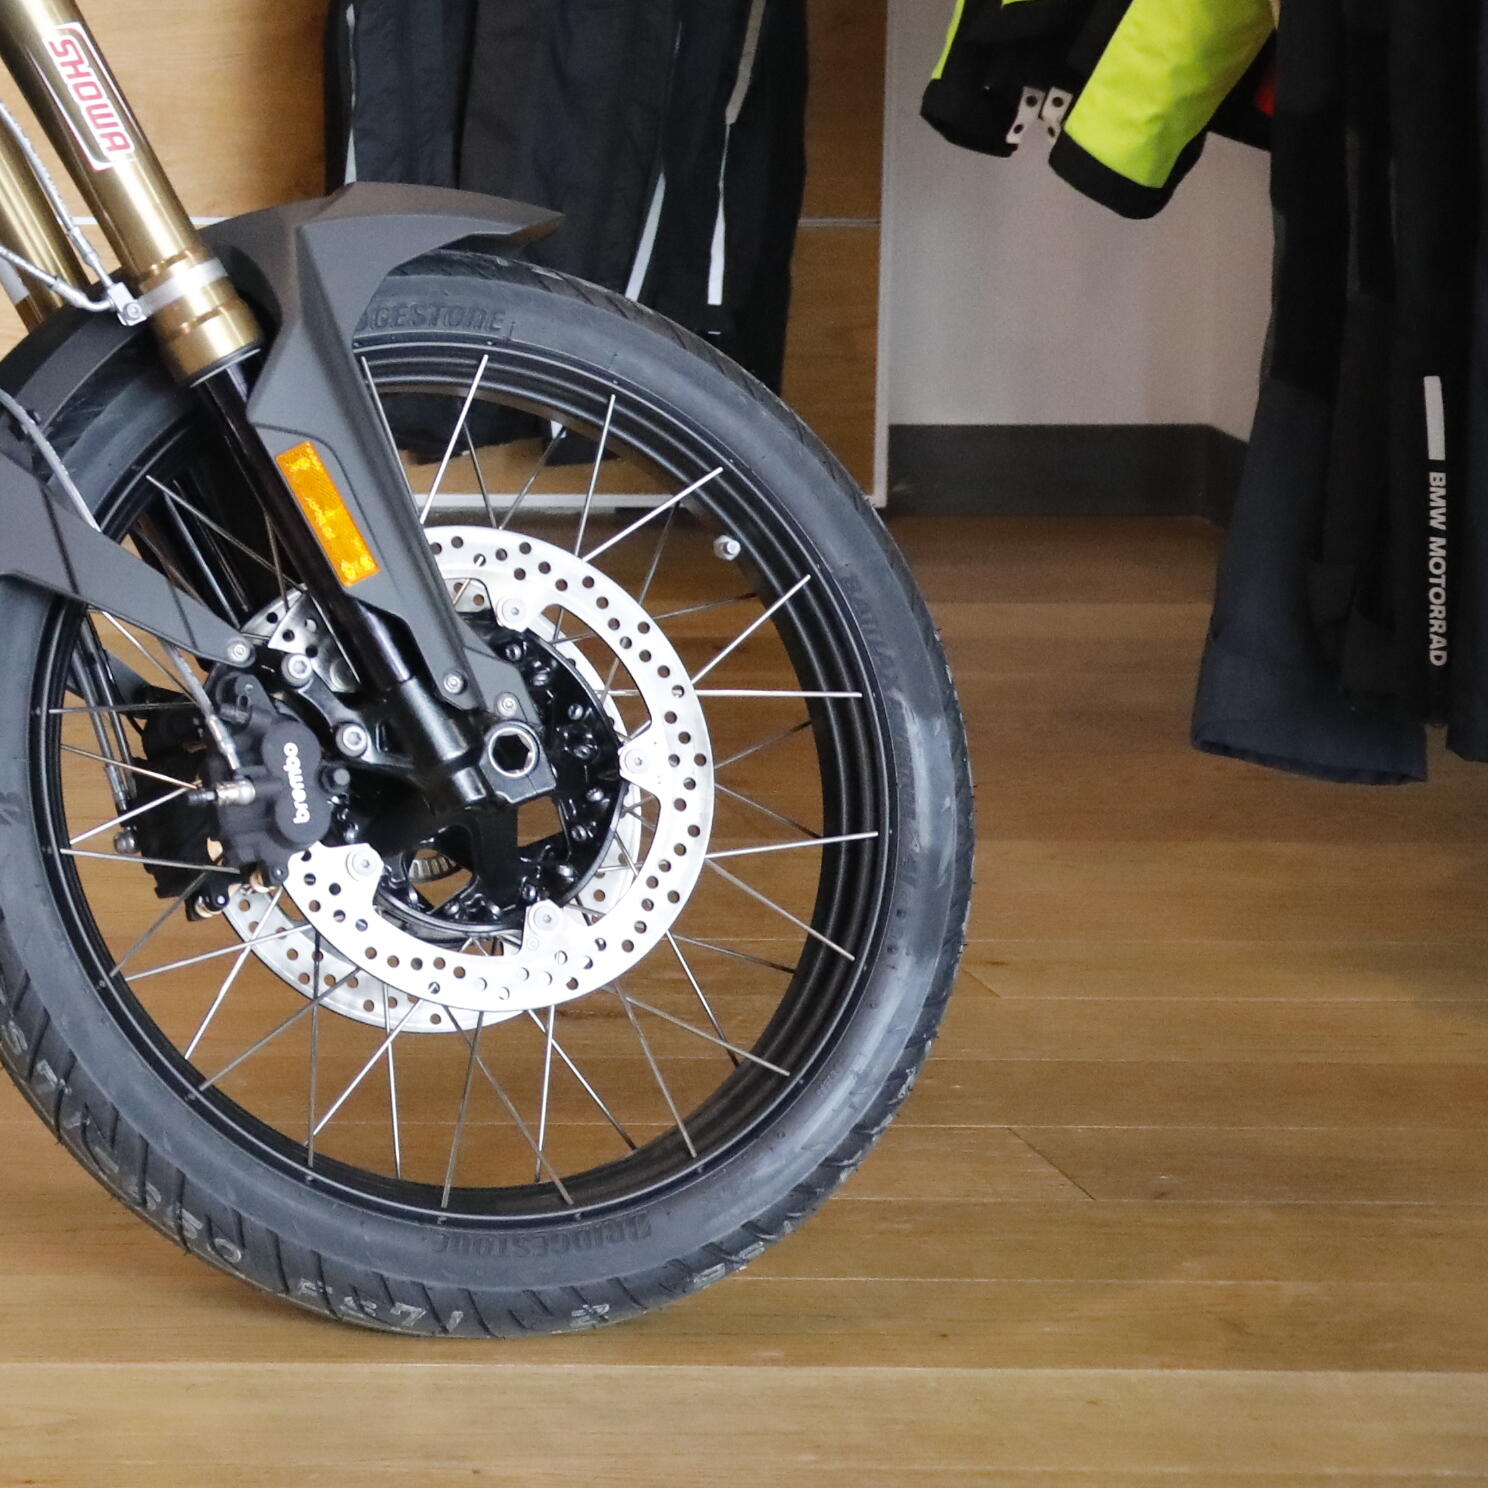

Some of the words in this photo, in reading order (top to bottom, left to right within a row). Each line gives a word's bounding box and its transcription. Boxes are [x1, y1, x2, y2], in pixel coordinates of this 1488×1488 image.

[48, 38, 131, 153] SHOWA
[1428, 471, 1447, 531] BMW
[1428, 536, 1448, 667] MOTORRAD
[283, 742, 311, 825] brembo
